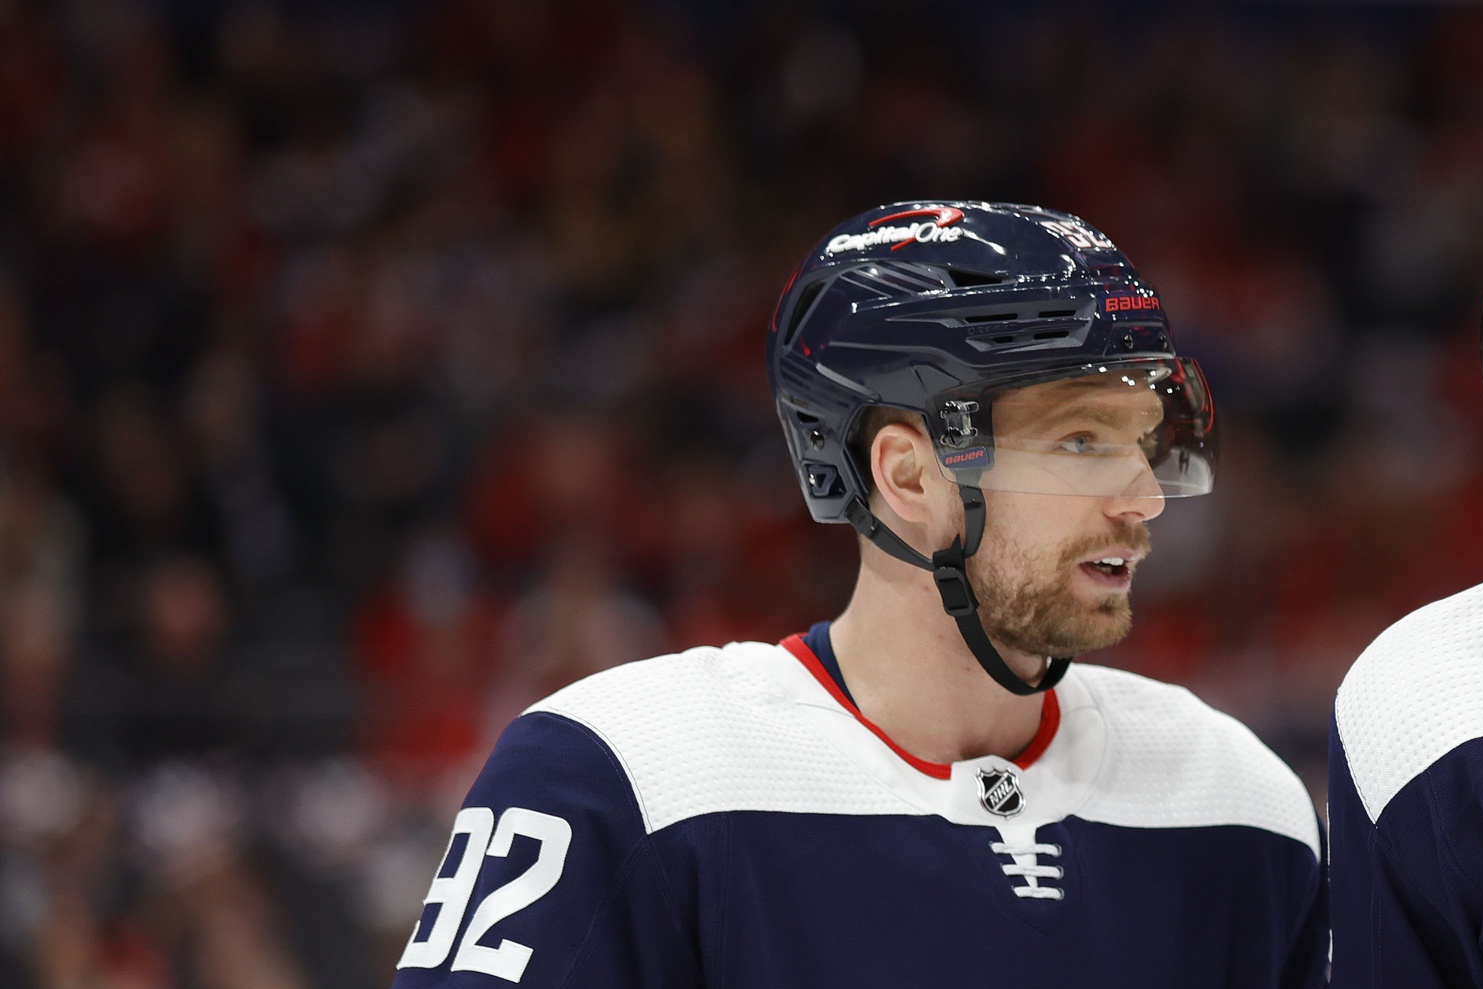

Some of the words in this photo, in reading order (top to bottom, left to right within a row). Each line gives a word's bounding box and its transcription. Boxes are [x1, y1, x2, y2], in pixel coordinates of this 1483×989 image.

[1105, 296, 1160, 312] BAUER
[945, 450, 985, 465] BAUER
[989, 780, 1013, 807] NHL
[396, 807, 572, 984] 92
